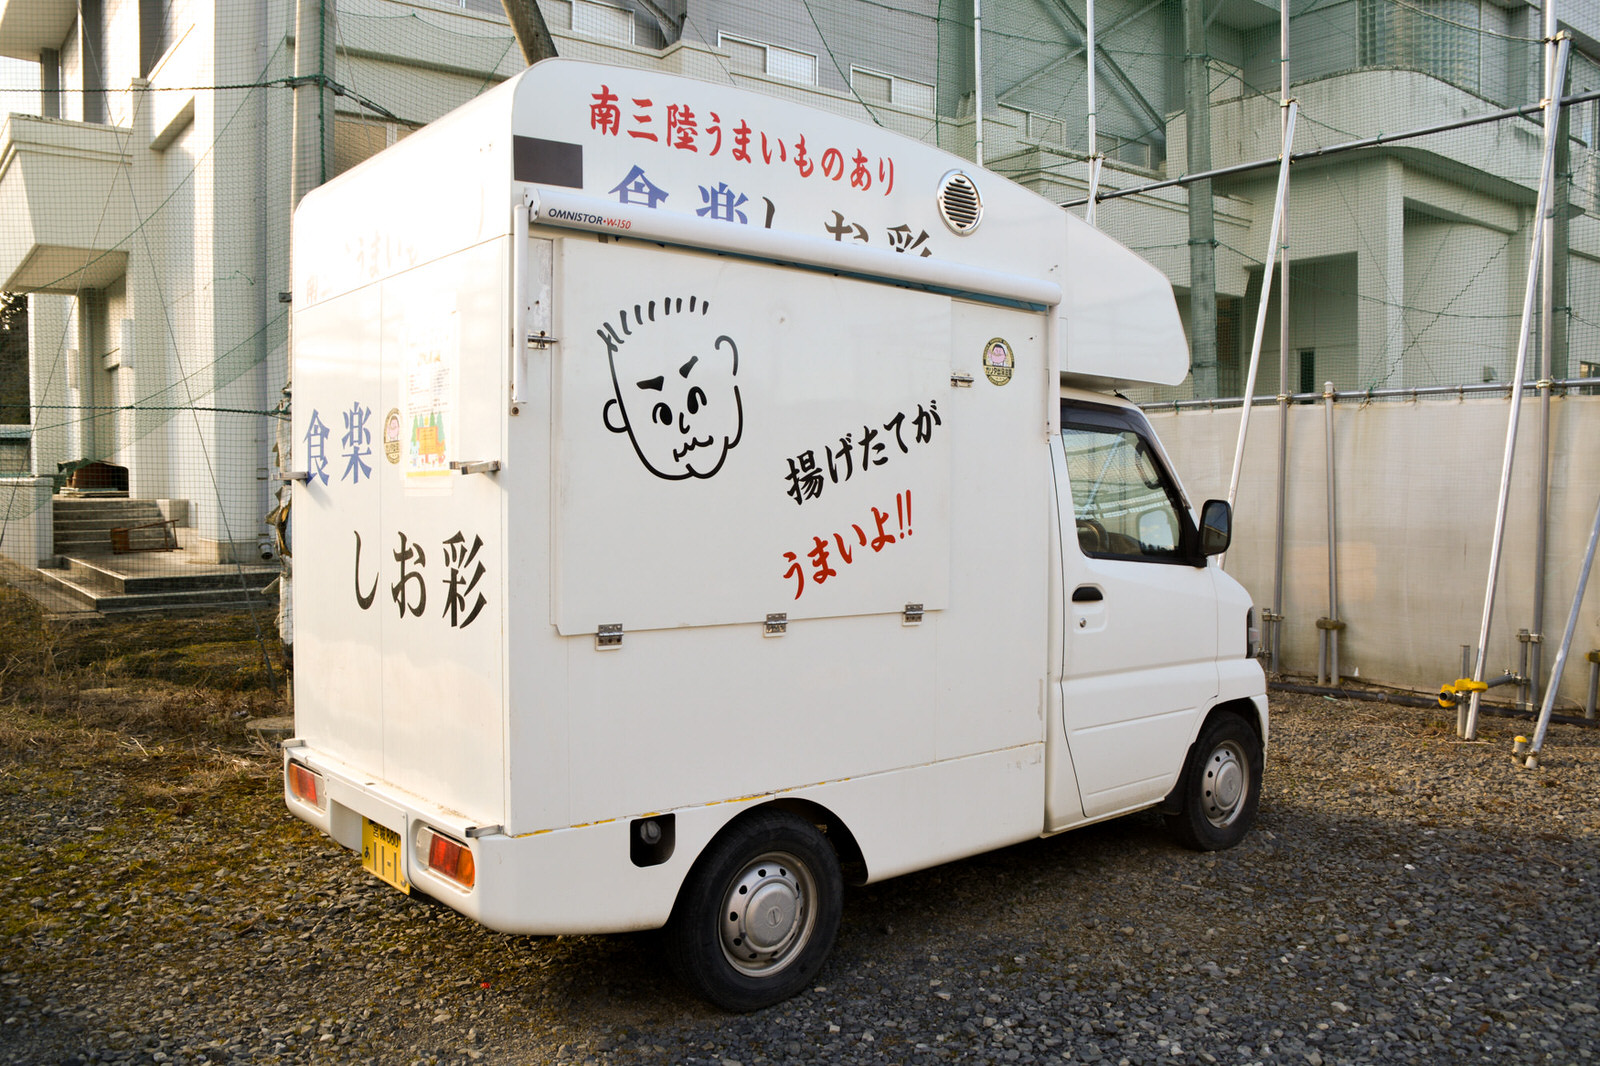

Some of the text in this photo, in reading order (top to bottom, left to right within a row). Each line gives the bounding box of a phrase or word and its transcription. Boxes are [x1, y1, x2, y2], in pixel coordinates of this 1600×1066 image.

[589, 84, 895, 196] 南三陸うまいものあり
[303, 401, 372, 487] 食楽
[784, 400, 942, 505] 揚げたてが
[353, 530, 488, 629] しお彩
